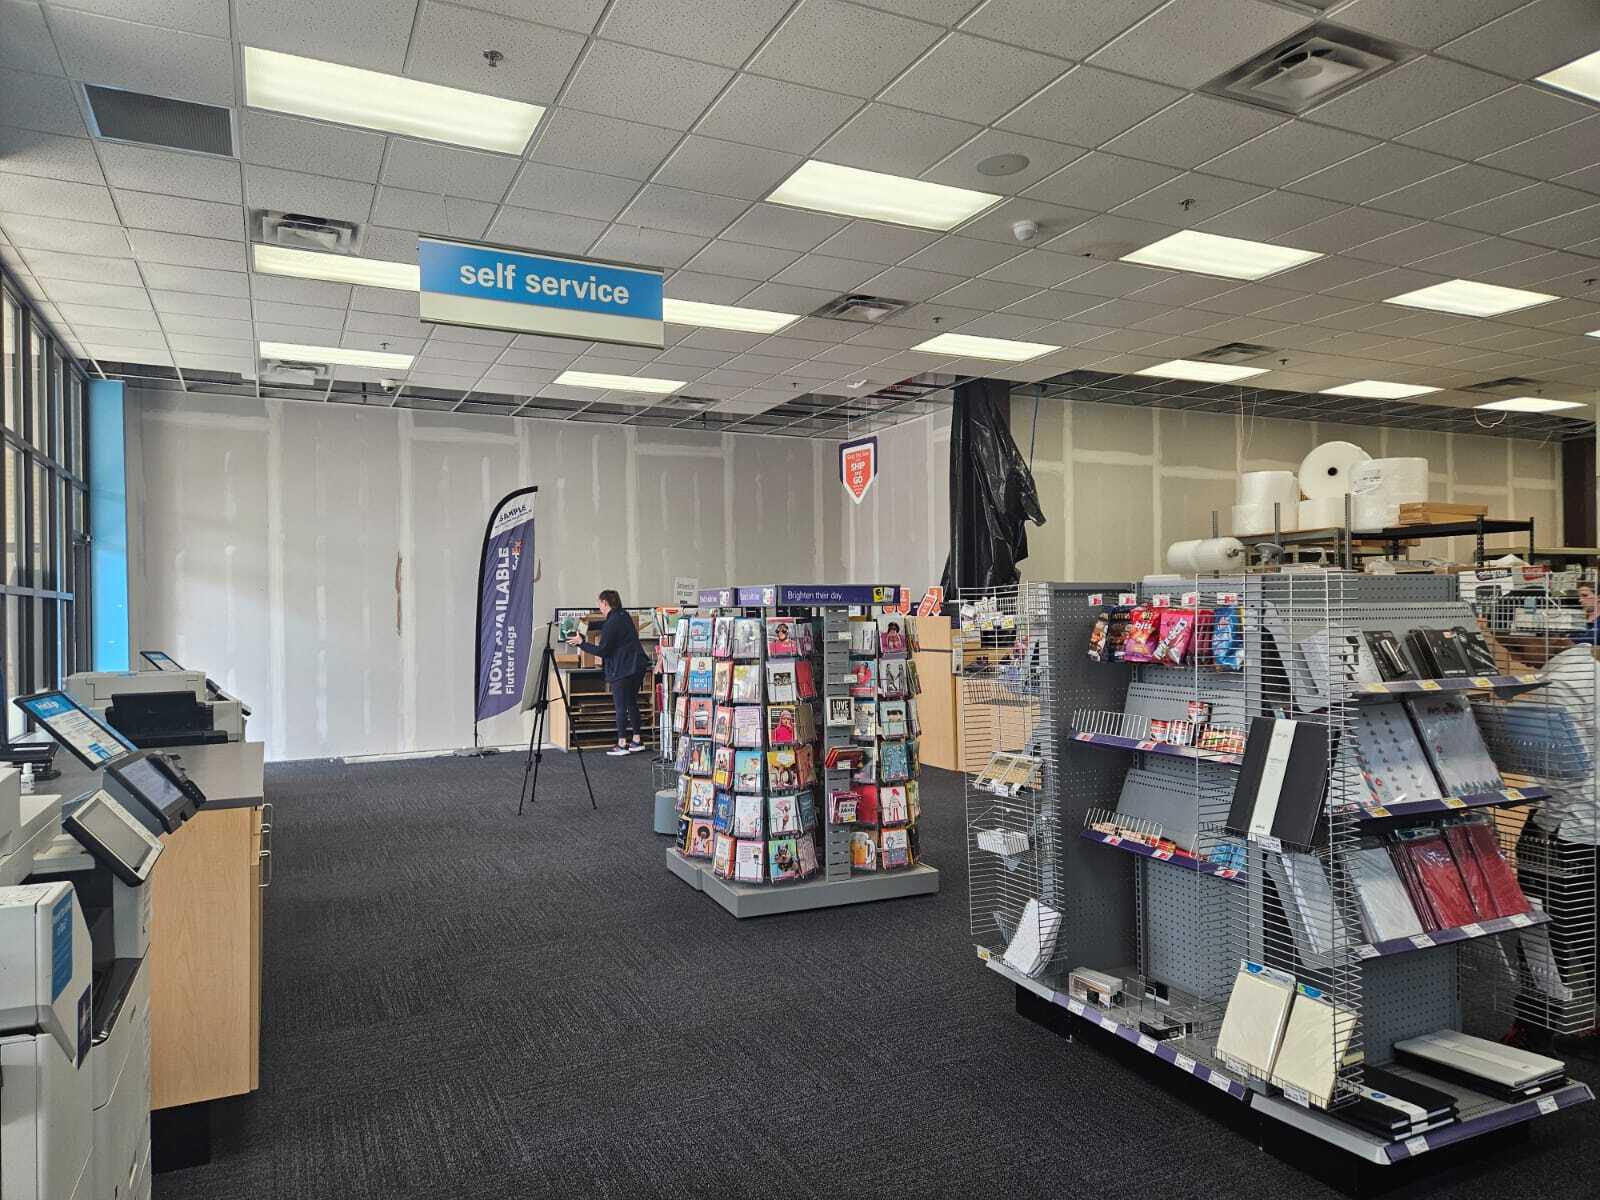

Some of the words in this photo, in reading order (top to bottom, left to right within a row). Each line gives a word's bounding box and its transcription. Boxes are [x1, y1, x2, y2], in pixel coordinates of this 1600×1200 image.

[459, 262, 517, 291] self
[525, 275, 630, 305] service
[498, 504, 528, 522] SAMPLE
[495, 546, 511, 647] AVAILABLE
[787, 590, 814, 601] Brighten
[830, 591, 843, 601] day
[505, 625, 518, 654] flags
[488, 651, 503, 696] NOW
[505, 655, 516, 695] Flutter
[832, 700, 849, 711] LOVE
